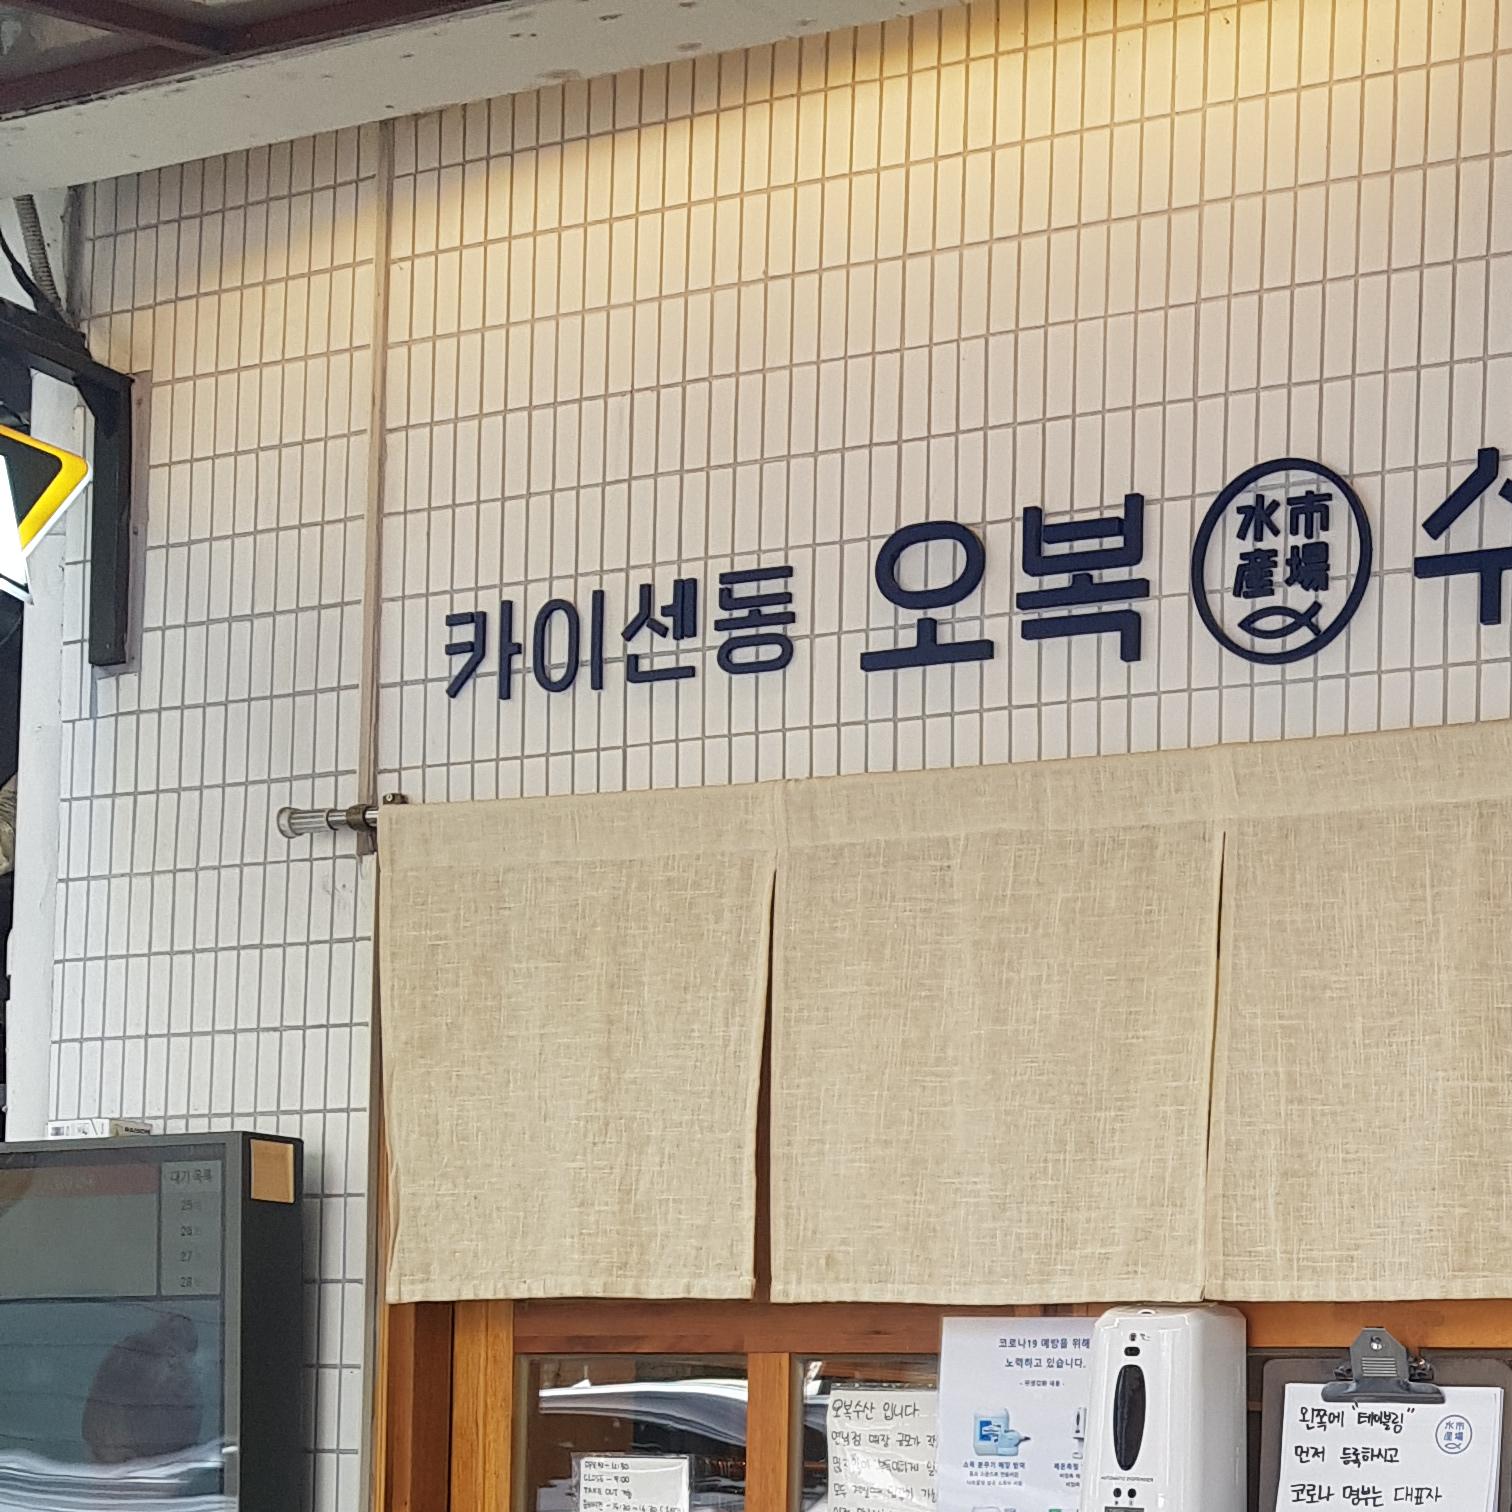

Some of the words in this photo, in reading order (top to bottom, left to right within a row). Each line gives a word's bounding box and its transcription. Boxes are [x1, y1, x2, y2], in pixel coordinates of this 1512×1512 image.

[445, 565, 797, 701] 카이센동
[860, 493, 1151, 671] 오복
[998, 1338, 1038, 1349] 코로나19
[1040, 1338, 1068, 1349] 예방을
[1072, 1338, 1091, 1349] 위해
[1004, 1357, 1043, 1369] 노력하고
[831, 1398, 876, 1421] 오복수산
[1298, 1406, 1345, 1432] 왼쪽에
[1294, 1445, 1326, 1464] 먼저
[1339, 1446, 1400, 1469] 등록하시고
[583, 1486, 603, 1496] TAKE
[604, 1487, 619, 1497] OUT
[1290, 1483, 1336, 1504] 코로나
[1342, 1484, 1385, 1508] 명부는
[1393, 1486, 1443, 1506] 대표자
